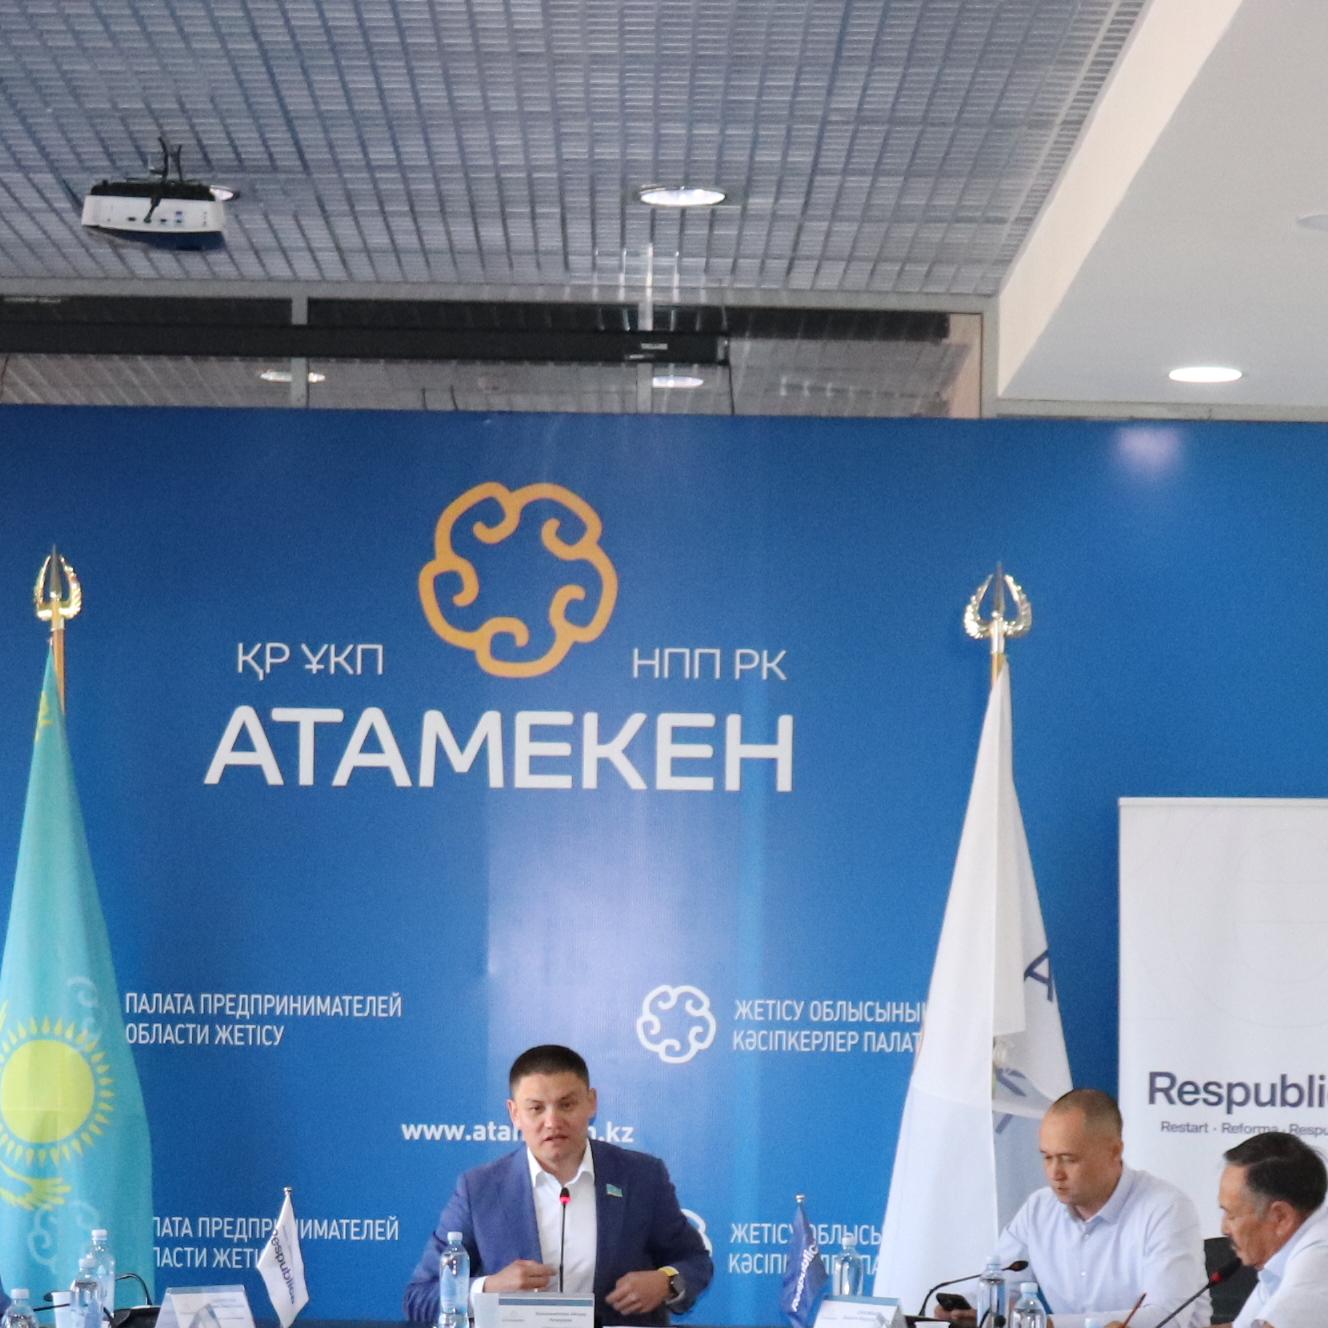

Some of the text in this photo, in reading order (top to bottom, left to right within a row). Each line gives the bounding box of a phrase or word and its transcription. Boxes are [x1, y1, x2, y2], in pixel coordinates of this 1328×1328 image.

[237, 642, 290, 681] ҚР
[633, 647, 788, 680] НПП РК
[202, 704, 794, 792] АТАМЕКЕН
[125, 992, 403, 1019] ПАЛАТА ПРЕДПРИНИМАТЕЛЕЙ
[735, 1000, 927, 1023] ЖЕТІСУ ОБЛЫСЫНЫ
[125, 1022, 285, 1046] ОБЛАСТИ ЖЕТІСУ
[733, 1030, 921, 1054] КӘСІПКЕРЛЕР ПАЛАТ
[1160, 1120, 1209, 1134] Restart
[198, 1216, 399, 1242] ПРЕДПРИМАТЕЛЕЙ
[730, 1223, 794, 1244] ЖЕТІС
[212, 1247, 260, 1269] ЖЕТІ
